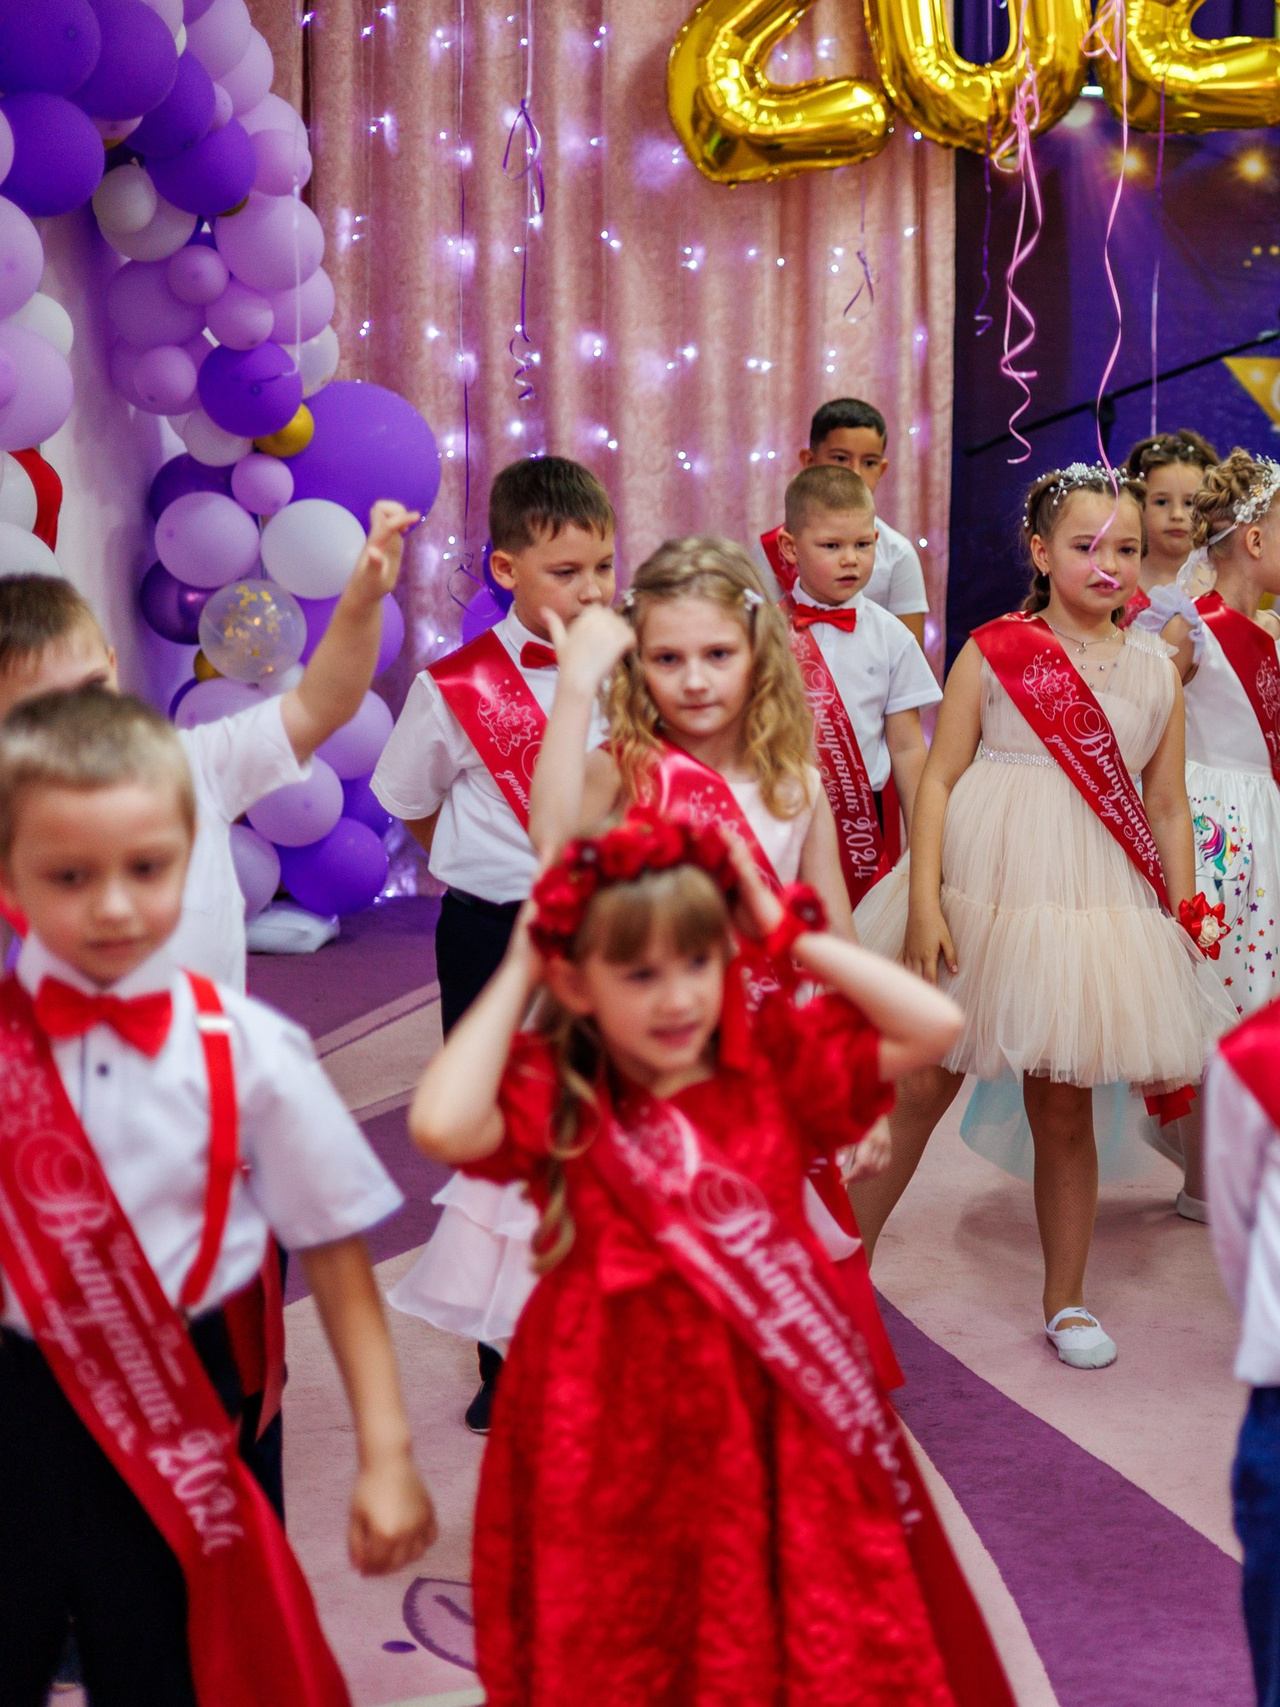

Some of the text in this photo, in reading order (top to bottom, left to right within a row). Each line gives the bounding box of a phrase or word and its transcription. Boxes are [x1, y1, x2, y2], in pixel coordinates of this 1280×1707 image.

[1044, 733, 1100, 794] детского
[1098, 795, 1123, 825] сада
[841, 817, 878, 879] 2024
